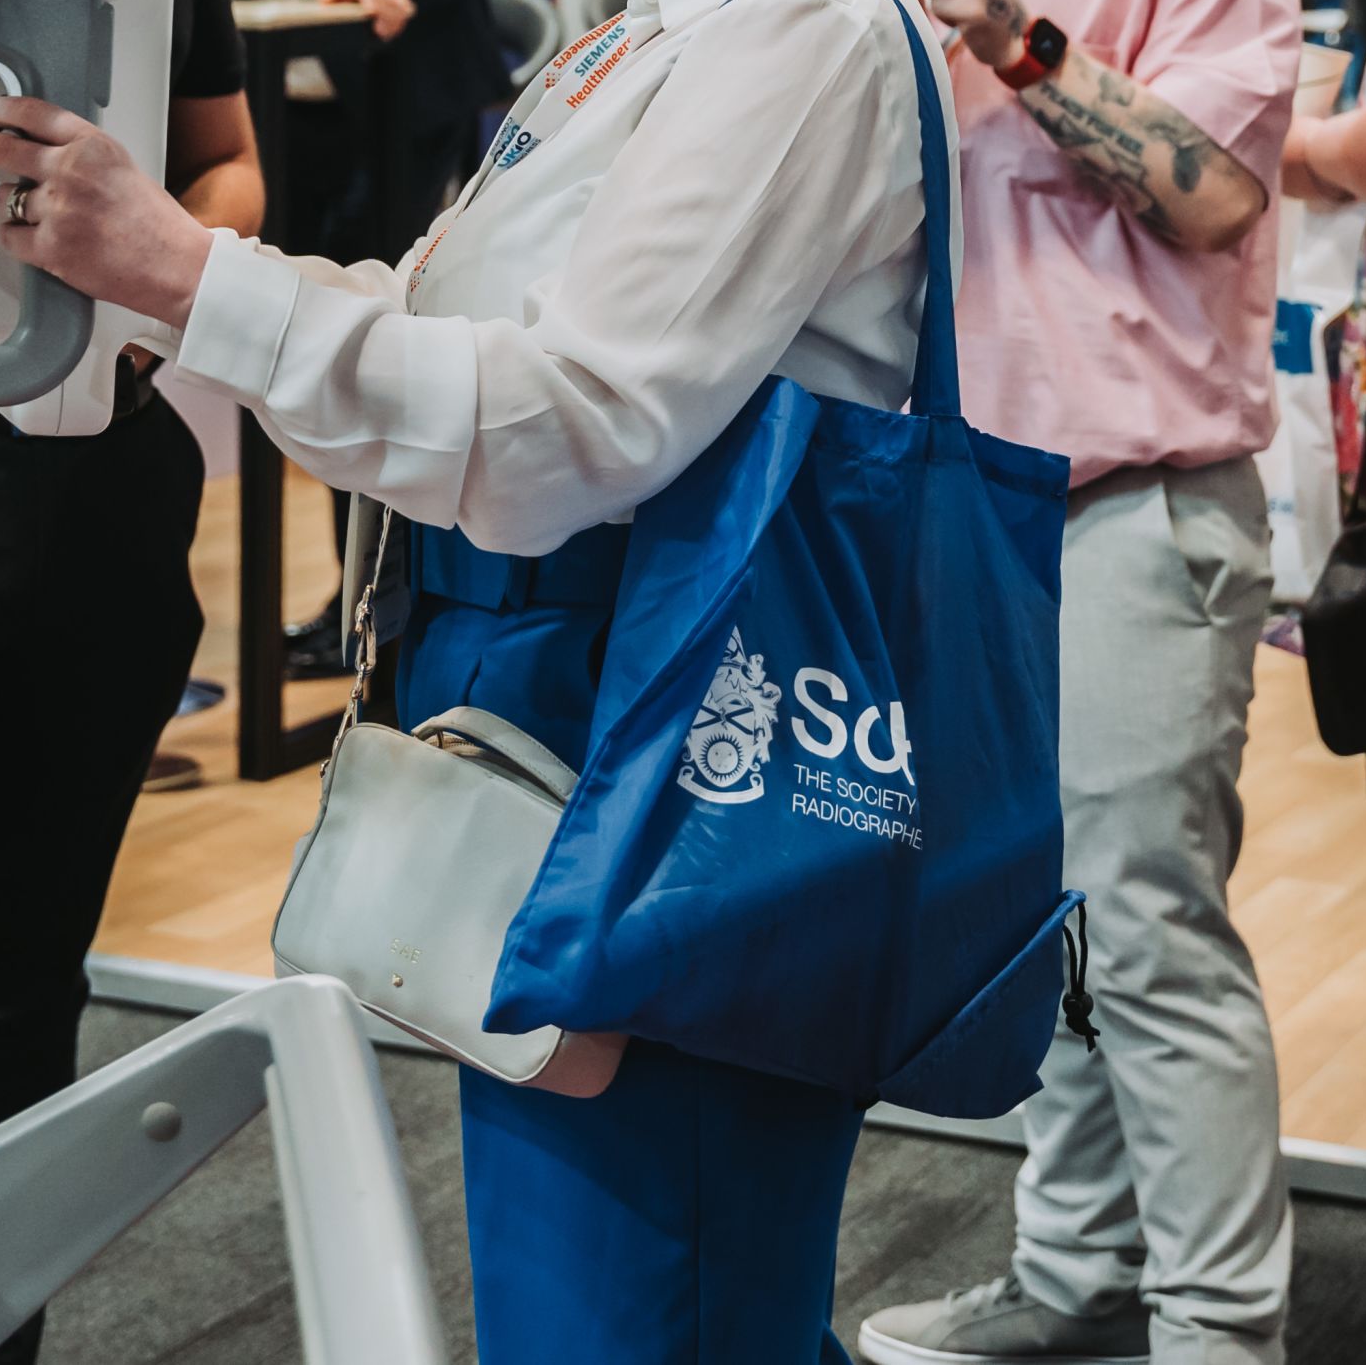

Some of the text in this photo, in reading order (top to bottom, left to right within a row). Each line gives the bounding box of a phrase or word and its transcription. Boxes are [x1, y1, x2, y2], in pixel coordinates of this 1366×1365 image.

[574, 24, 626, 78] SIEMENS
[793, 764, 916, 815] THE SOCIETY
[792, 793, 923, 850] RADIOGRAPHE
